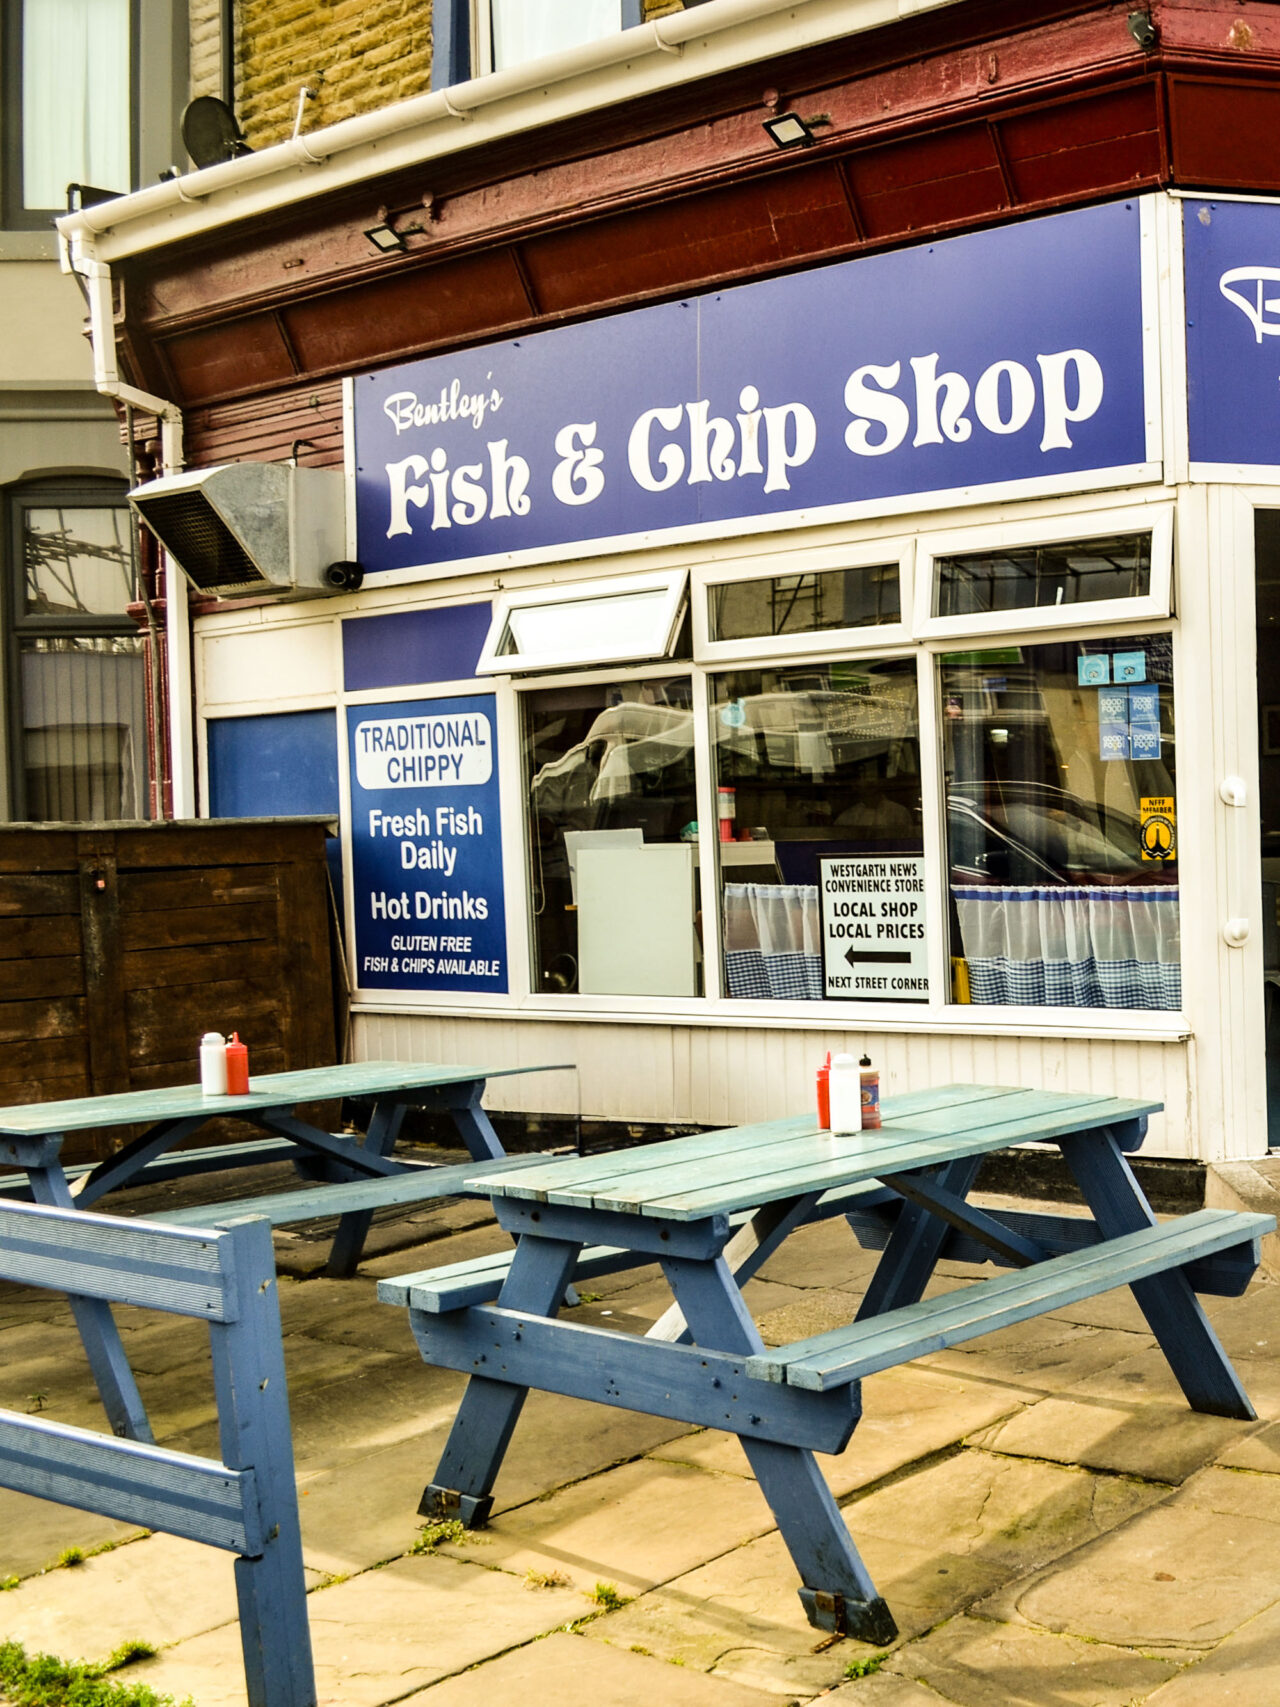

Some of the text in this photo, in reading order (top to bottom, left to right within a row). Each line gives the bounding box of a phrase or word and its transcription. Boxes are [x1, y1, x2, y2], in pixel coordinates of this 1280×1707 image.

[383, 371, 503, 436] Bentley's
[384, 348, 1104, 539] Fish & Chip Shop
[360, 719, 486, 753] TRADITIONAL
[387, 753, 463, 783] CHIPPY
[369, 806, 483, 838] Fresh Fish
[401, 841, 457, 876] Daily
[830, 863, 917, 878] WESTGARTH NEWS
[825, 879, 924, 893] CONVENIENCE STORE
[371, 890, 488, 920] Hot Drinks
[833, 902, 918, 917] LOCAL SHOP
[829, 923, 924, 938] LOCAL PRICES
[391, 935, 472, 953] GLUTEN FREE
[364, 957, 500, 976] FISH & CHIPS AVAILABLE
[828, 976, 929, 990] NEXT STREET CORNER
